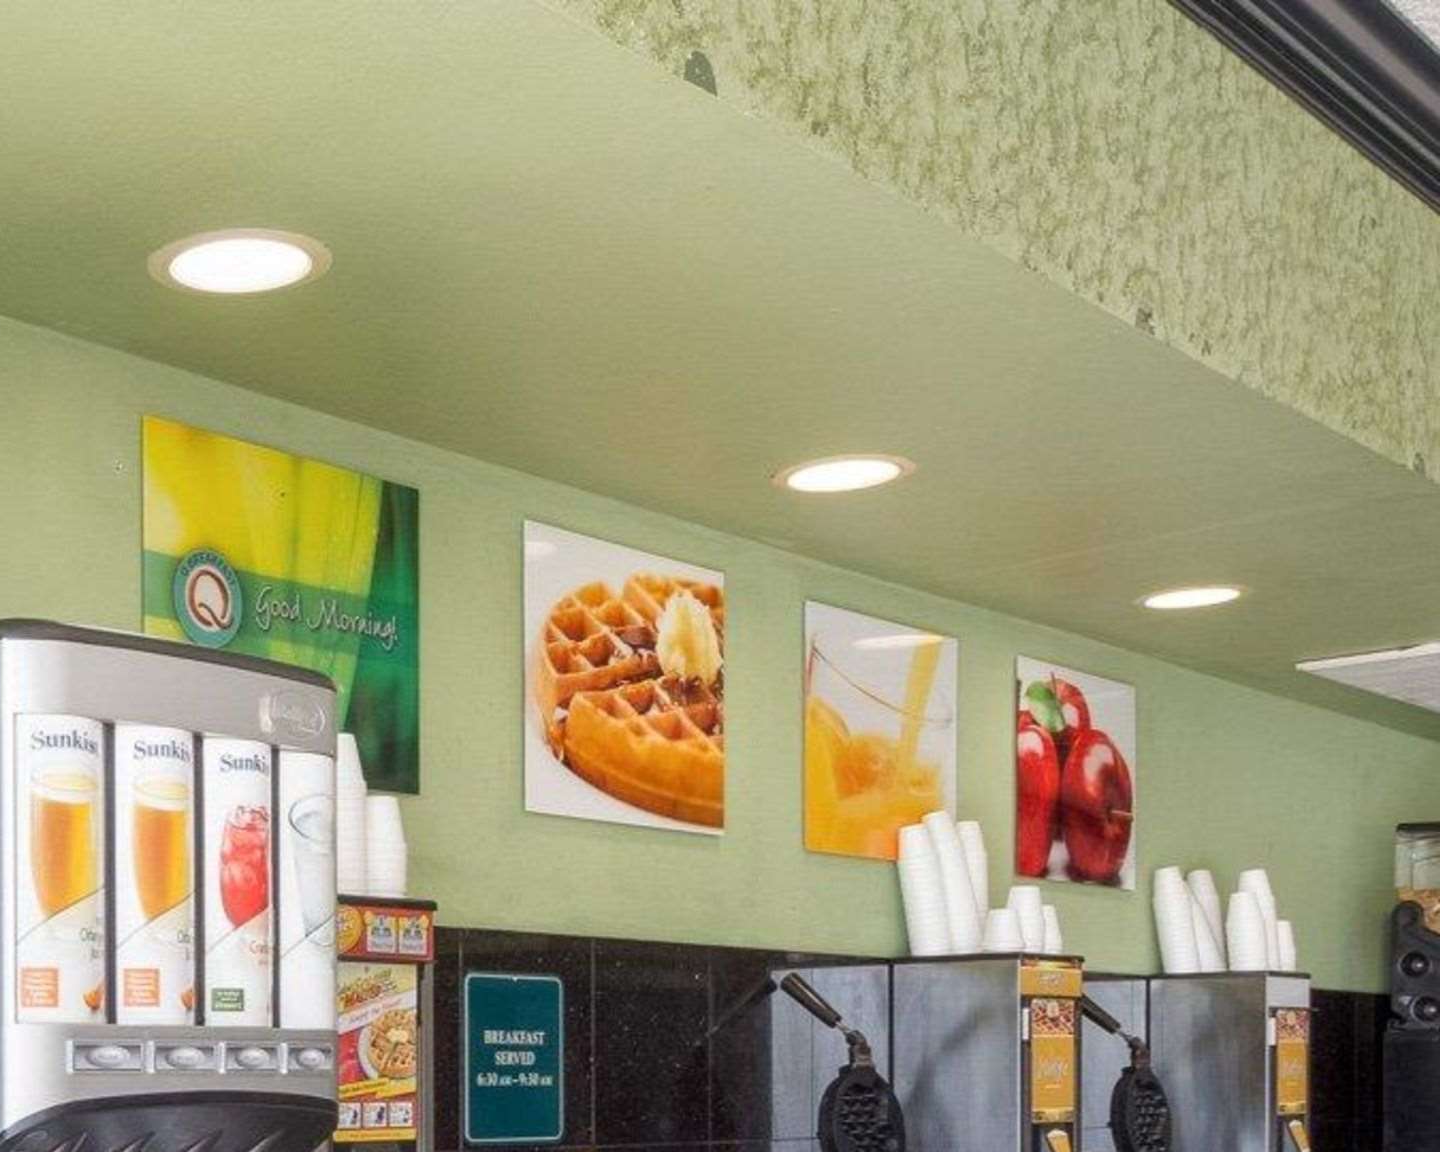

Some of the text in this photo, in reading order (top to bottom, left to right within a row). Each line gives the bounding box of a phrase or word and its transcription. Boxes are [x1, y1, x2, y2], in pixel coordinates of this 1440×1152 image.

[255, 586, 398, 651] Good Morning!
[483, 1030, 545, 1045] BREAKFAST
[494, 1051, 536, 1066] SERVED
